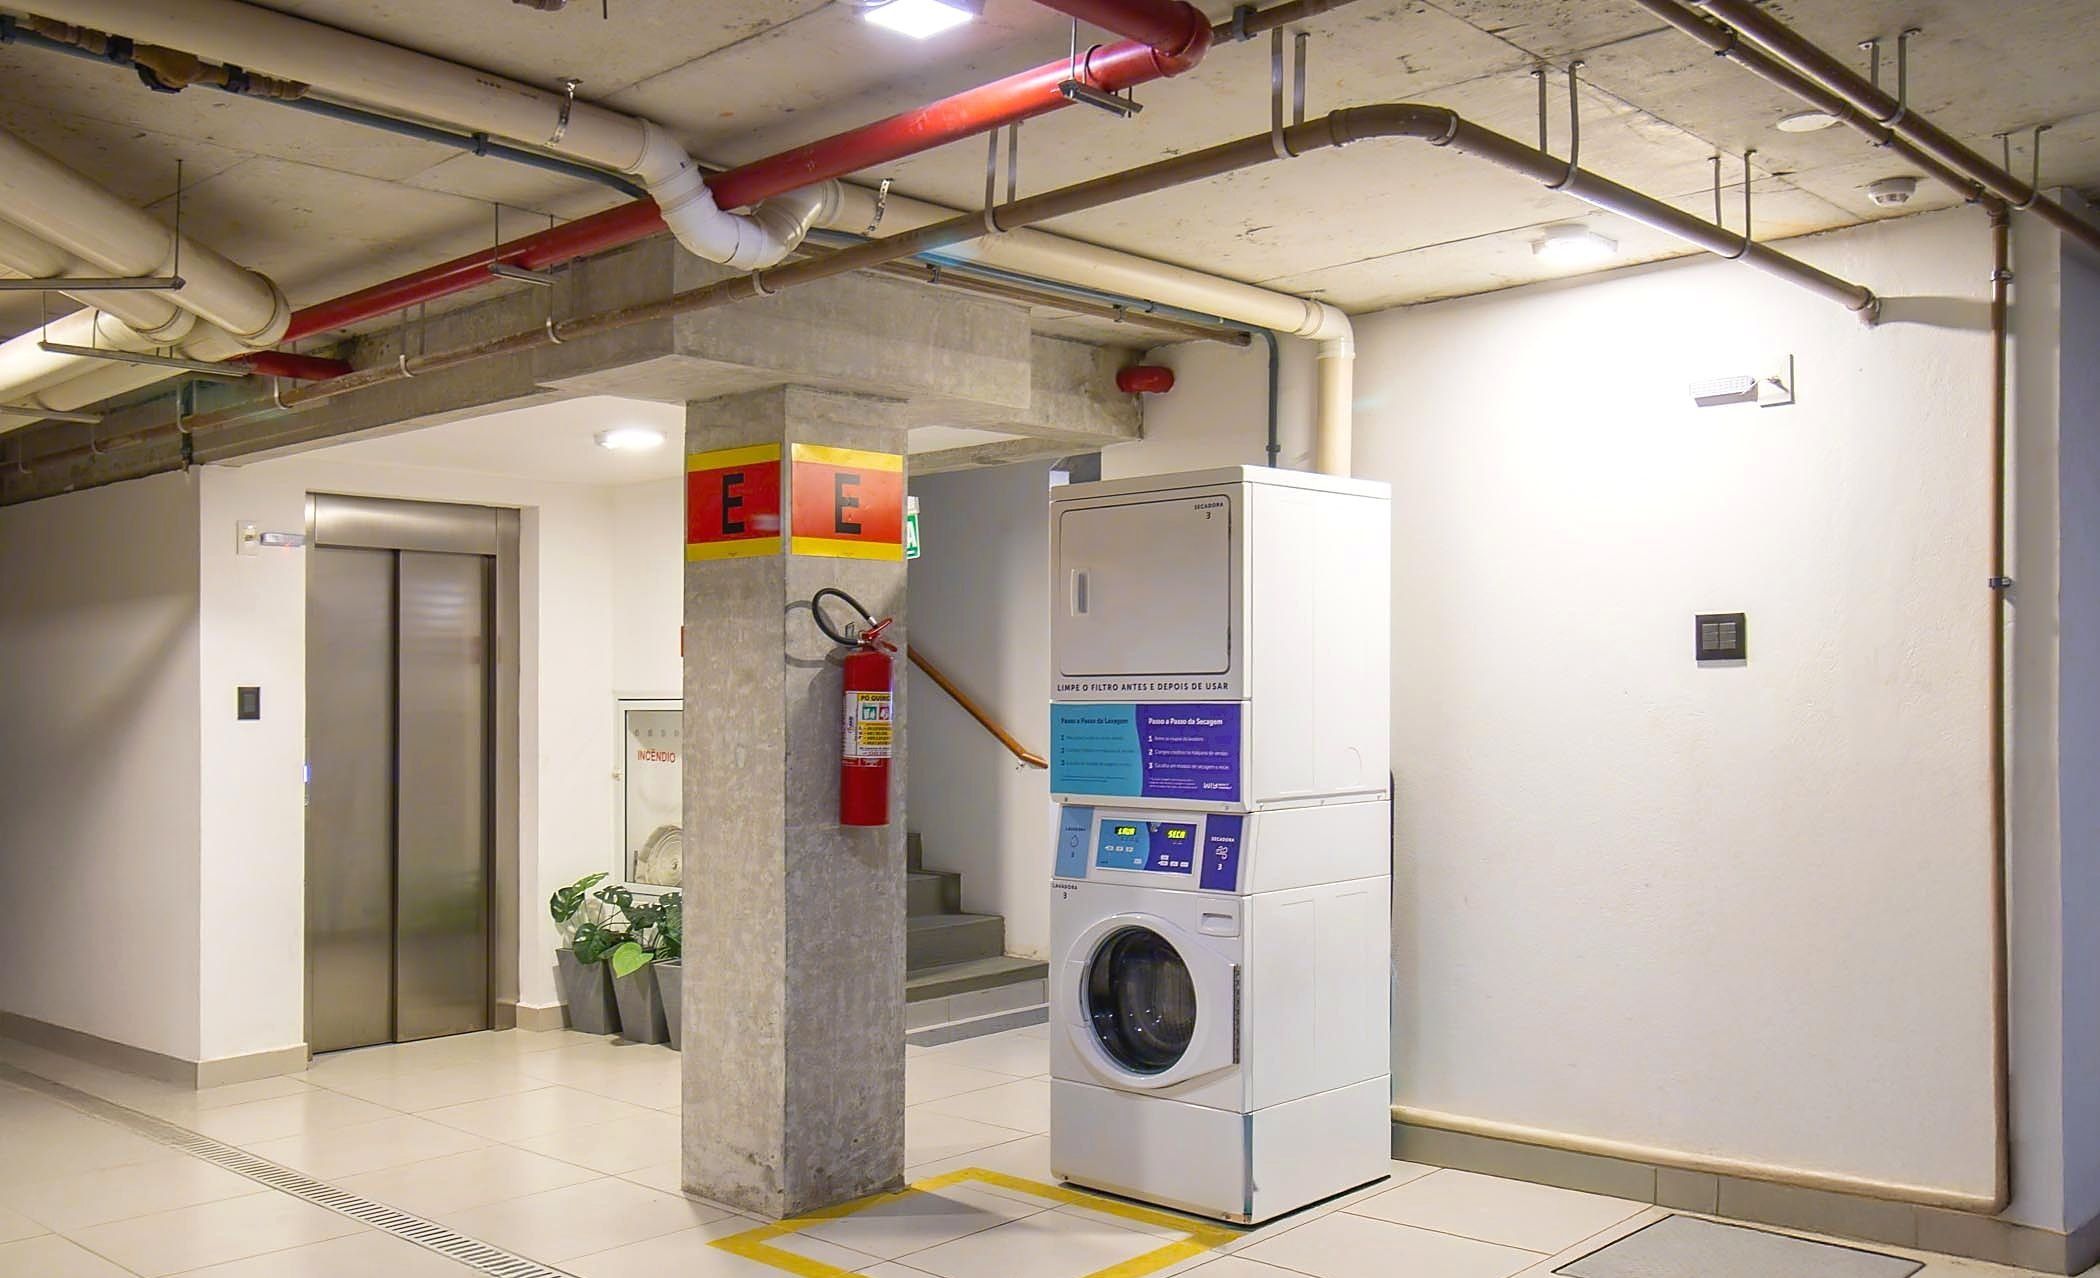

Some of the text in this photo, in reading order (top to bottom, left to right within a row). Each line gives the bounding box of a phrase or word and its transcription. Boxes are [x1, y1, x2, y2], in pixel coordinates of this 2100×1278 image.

[722, 472, 745, 534] E
[835, 472, 861, 534] E
[1205, 511, 1211, 520] 3
[1057, 684, 1080, 692] LIMPE
[1091, 683, 1118, 692] FILTRO
[1121, 683, 1147, 691] ANTES
[1150, 683, 1154, 691] E
[1157, 682, 1189, 691] DEPOIS
[1192, 682, 1202, 691] DE
[1206, 682, 1229, 690] USAR
[1148, 717, 1165, 725] Passo
[1170, 717, 1187, 725] Passo
[1196, 717, 1223, 727] Secagem
[1167, 829, 1186, 839] SECA
[1217, 863, 1223, 871] 3
